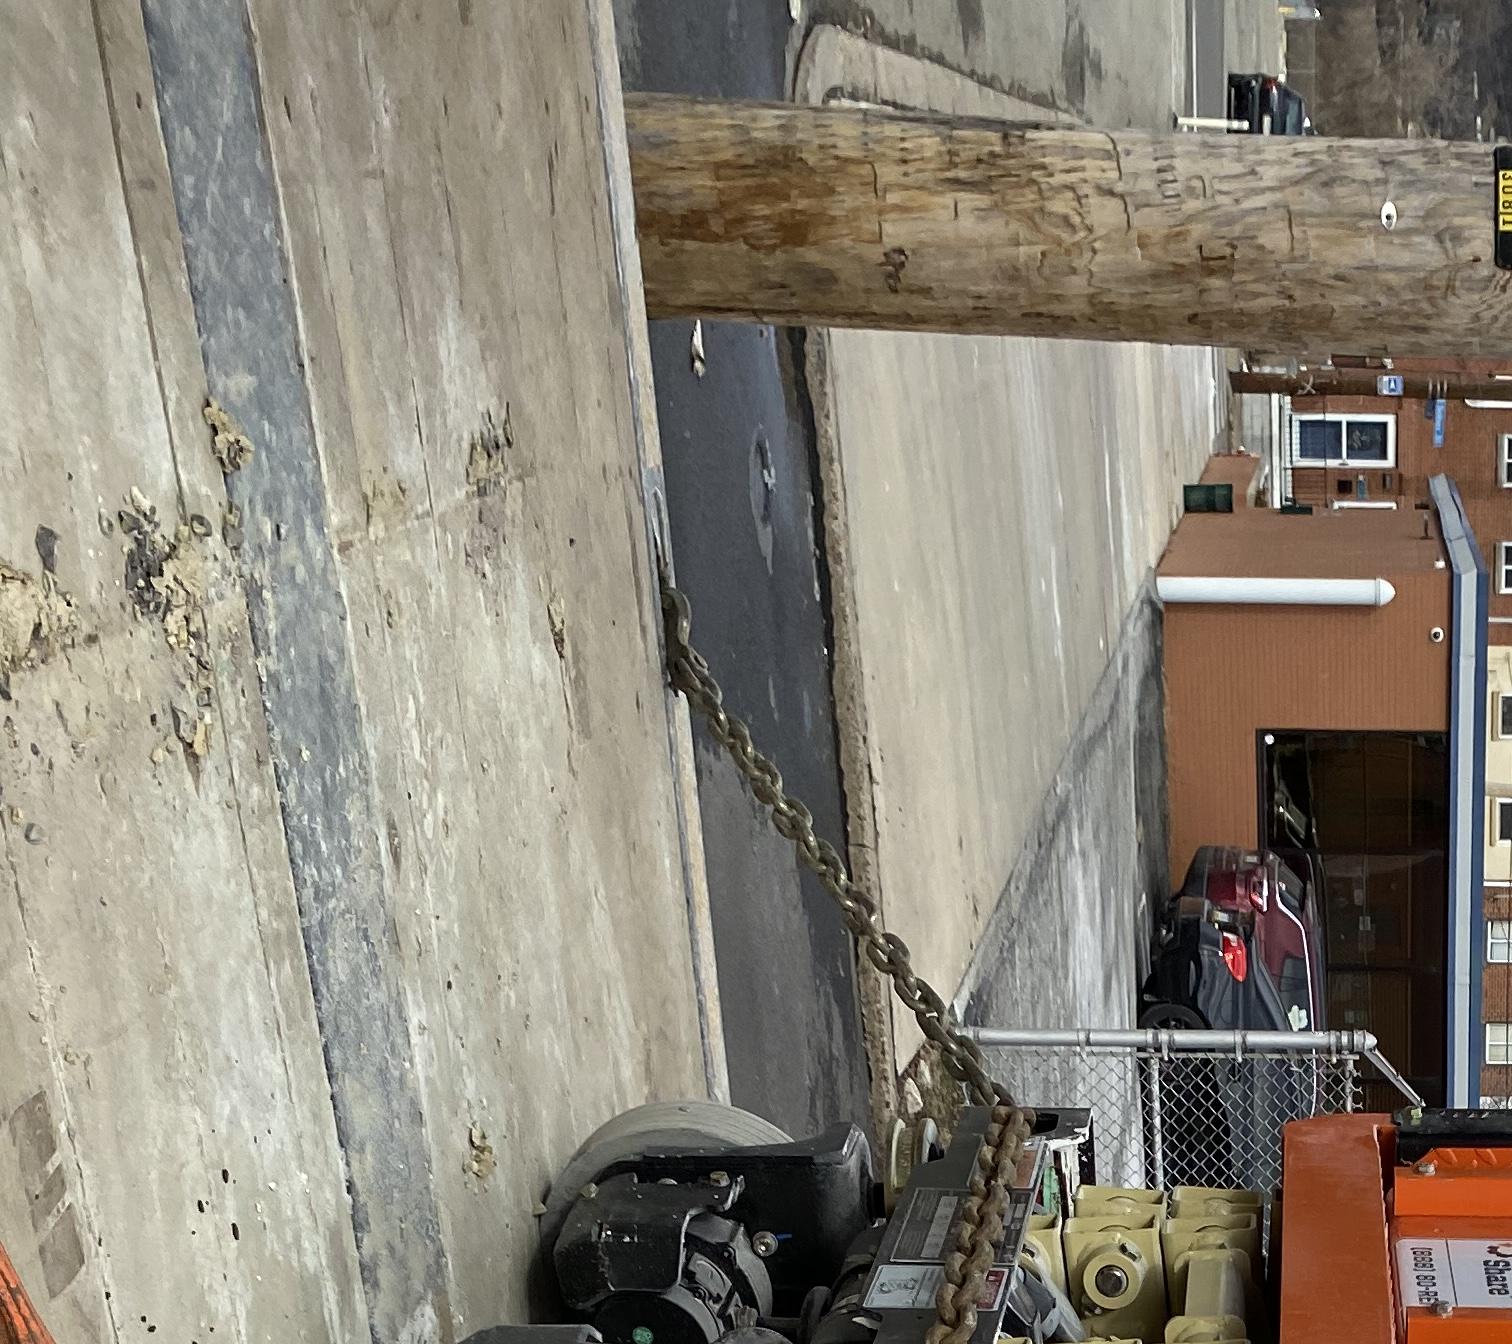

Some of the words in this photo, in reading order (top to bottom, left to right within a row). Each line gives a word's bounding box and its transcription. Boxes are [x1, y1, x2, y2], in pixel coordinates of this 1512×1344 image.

[1410, 1247, 1436, 1271] (888)
[1415, 1274, 1439, 1305] 80-RE
[1483, 1260, 1511, 1296] Share
